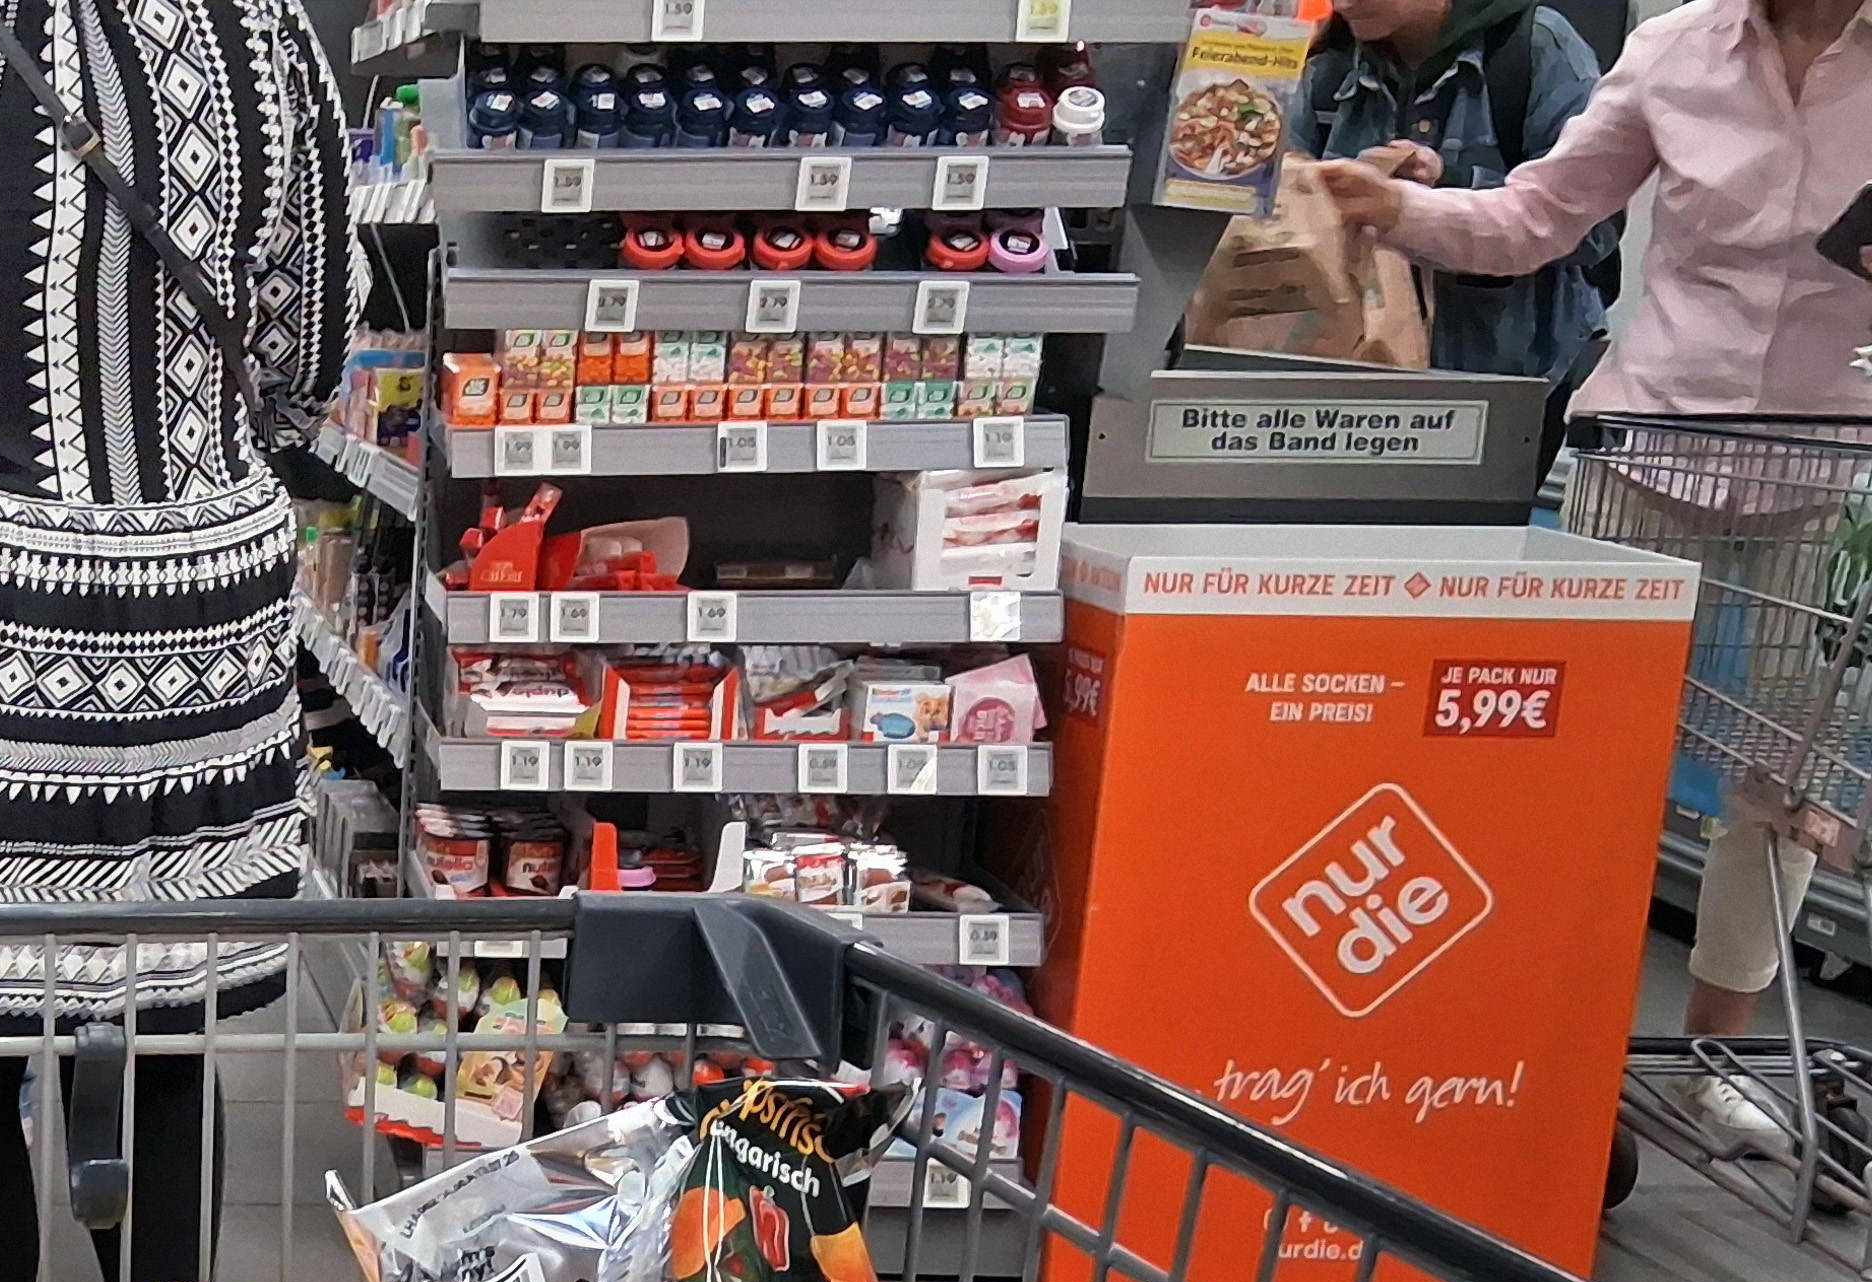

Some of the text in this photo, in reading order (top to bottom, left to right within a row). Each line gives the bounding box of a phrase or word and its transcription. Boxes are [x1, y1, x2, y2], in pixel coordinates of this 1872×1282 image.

[1182, 409, 1456, 431] Bitte alle Waren auf
[1211, 431, 1420, 455] das Band legen
[1143, 570, 1193, 595] NUR
[1202, 568, 1248, 595] FÜR
[1257, 572, 1335, 596] KURZE
[1342, 574, 1395, 597] ZEIT
[1439, 576, 1489, 599] NUR
[1497, 572, 1543, 599] FÜR
[1550, 577, 1627, 600] KURZE
[1634, 579, 1684, 601] ZEIT
[1246, 672, 1385, 695] ALLE SOCKEN
[1442, 666, 1557, 685] JE PACK NUR
[1269, 701, 1373, 723] EIN PREIS!
[1434, 688, 1551, 734] 5,99€
[1283, 813, 1408, 939] nur
[1336, 875, 1450, 975] die
[1335, 1064, 1391, 1102] ich
[1405, 1060, 1524, 1124] gern!
[710, 1119, 820, 1198] ungarisch
[1277, 1237, 1366, 1264] urdie.d
